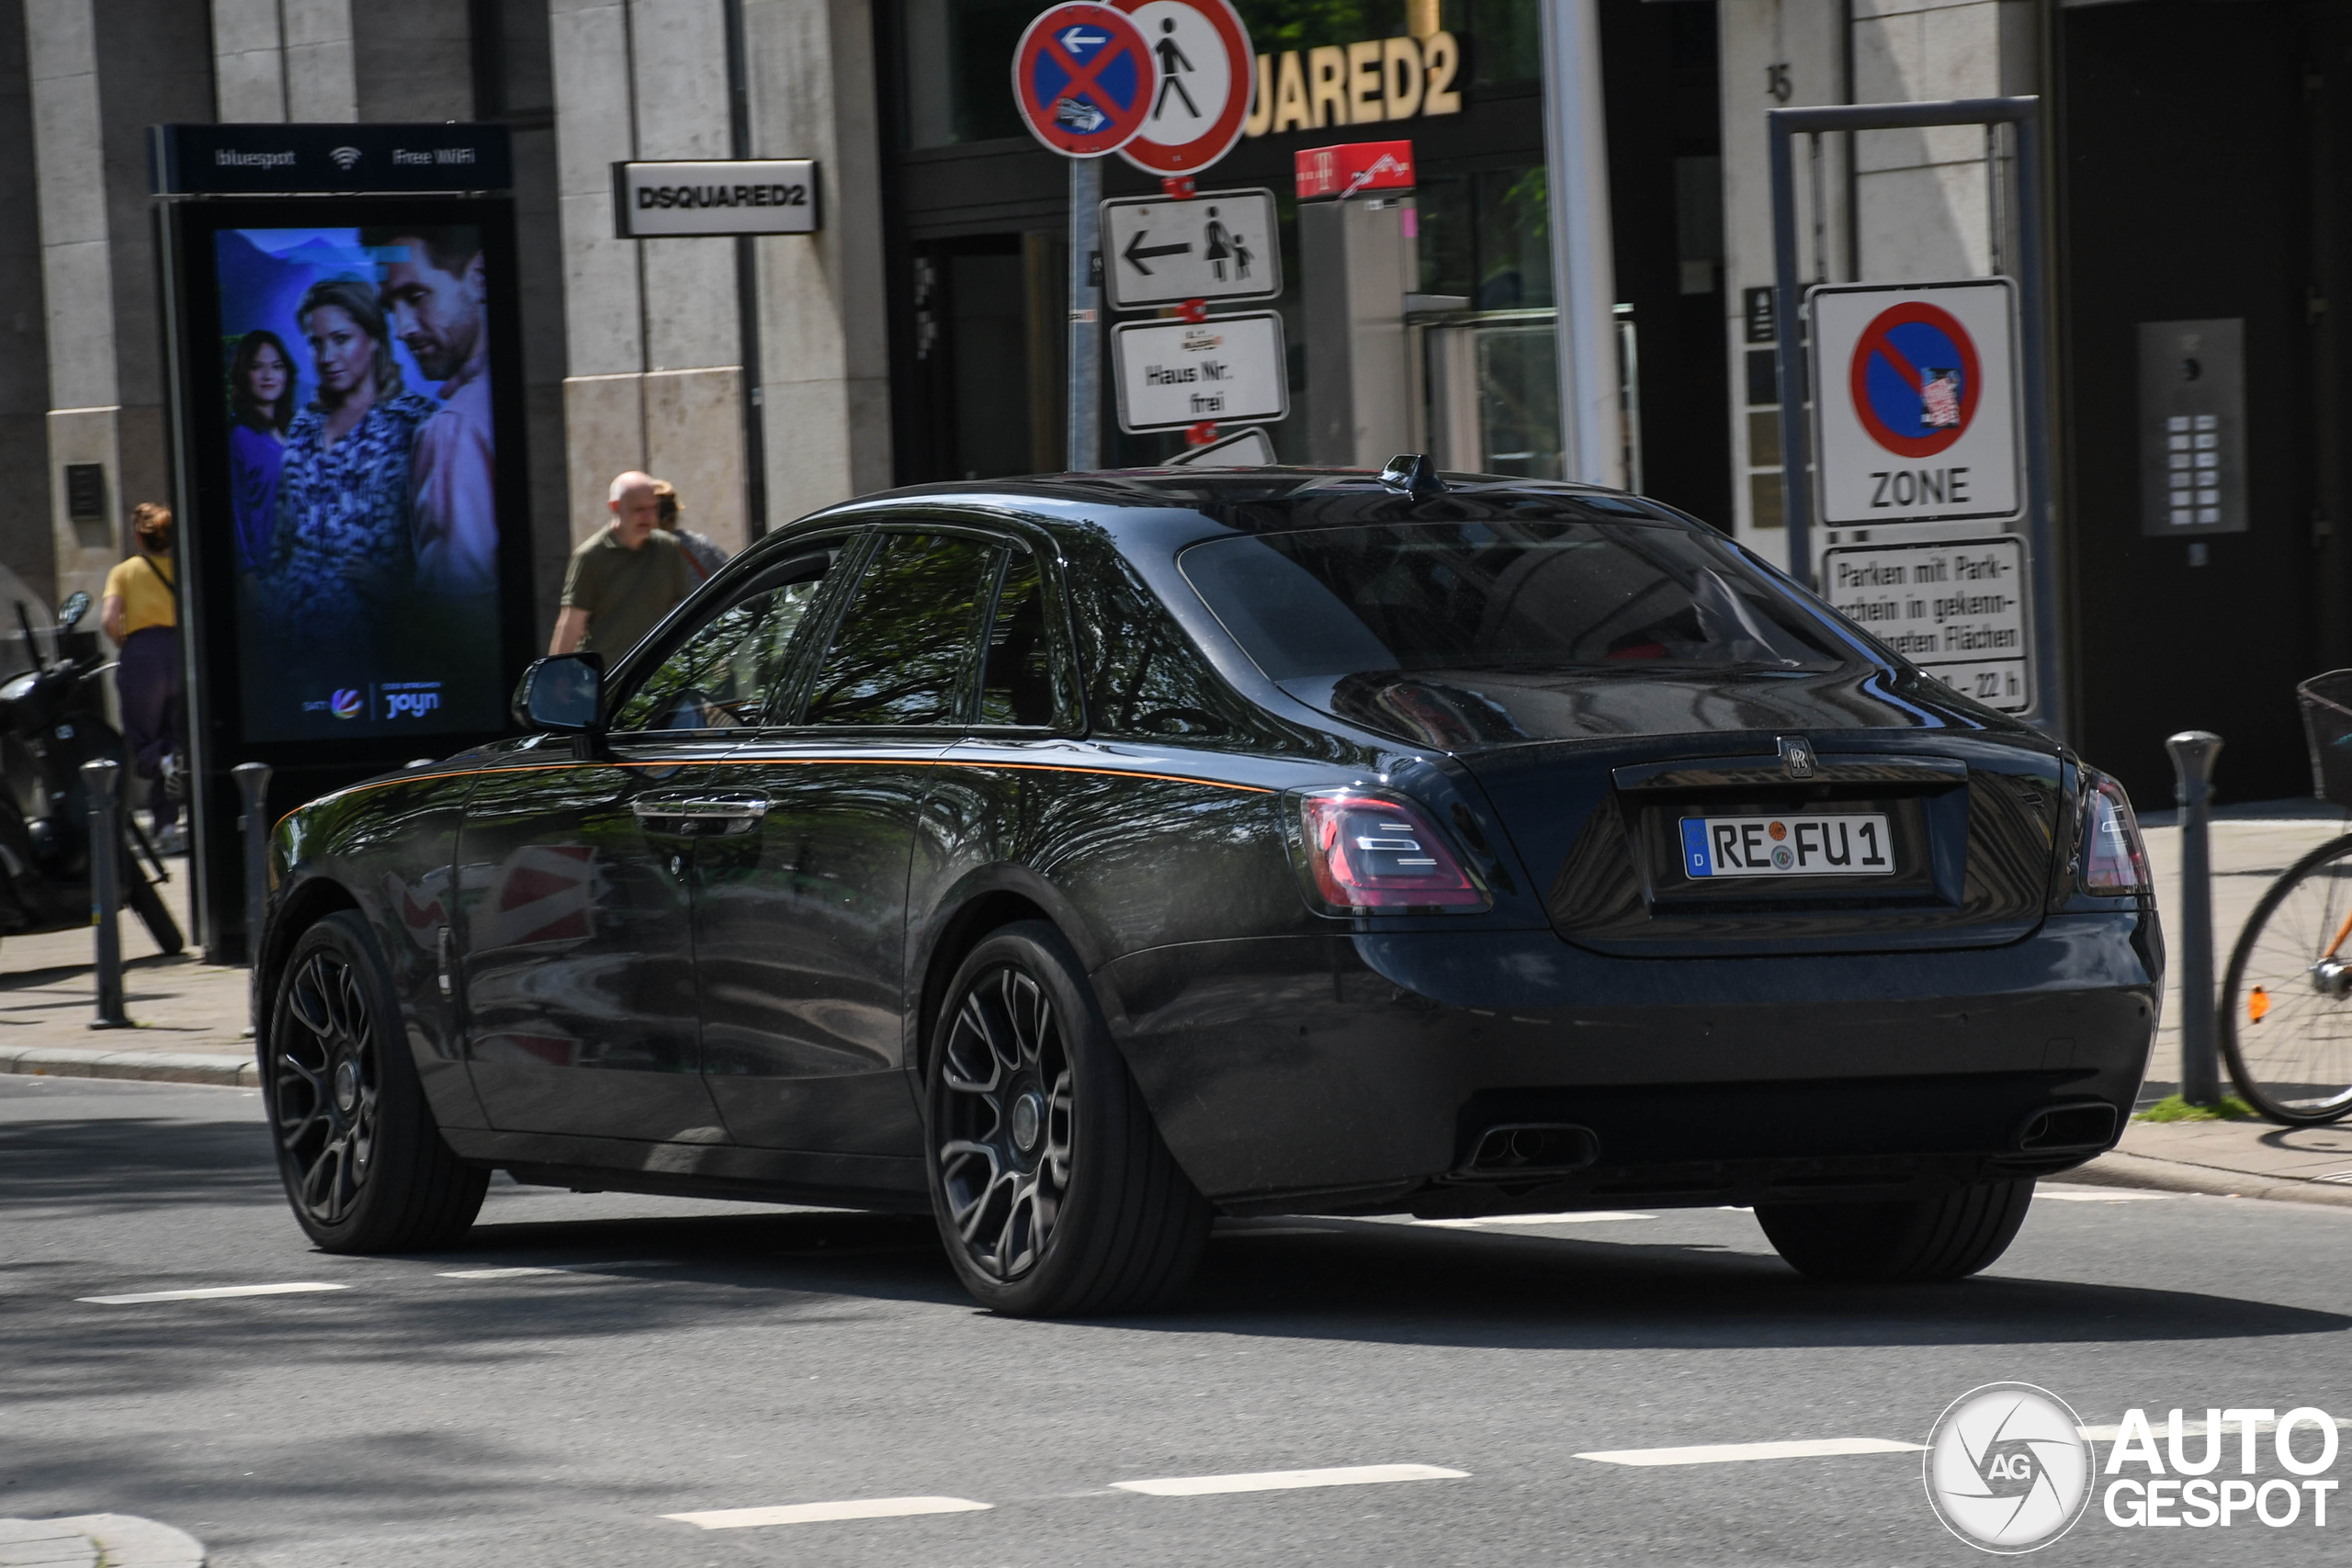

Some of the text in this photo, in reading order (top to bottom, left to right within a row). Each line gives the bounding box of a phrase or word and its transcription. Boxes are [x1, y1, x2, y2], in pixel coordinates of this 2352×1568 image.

[216, 150, 297, 169] bluespot
[392, 148, 433, 164] Free
[639, 184, 807, 209] DSQUARED2
[1146, 367, 1198, 386] Haus
[1191, 391, 1225, 413] frei
[1870, 467, 1971, 508] ZONE
[1838, 553, 2012, 588] Parken mit Park-
[1905, 593, 1926, 619] in
[1933, 590, 2015, 624] gekenn-
[1945, 623, 2017, 651] Flächen
[1976, 672, 1999, 698] 22
[385, 692, 439, 719] joyn
